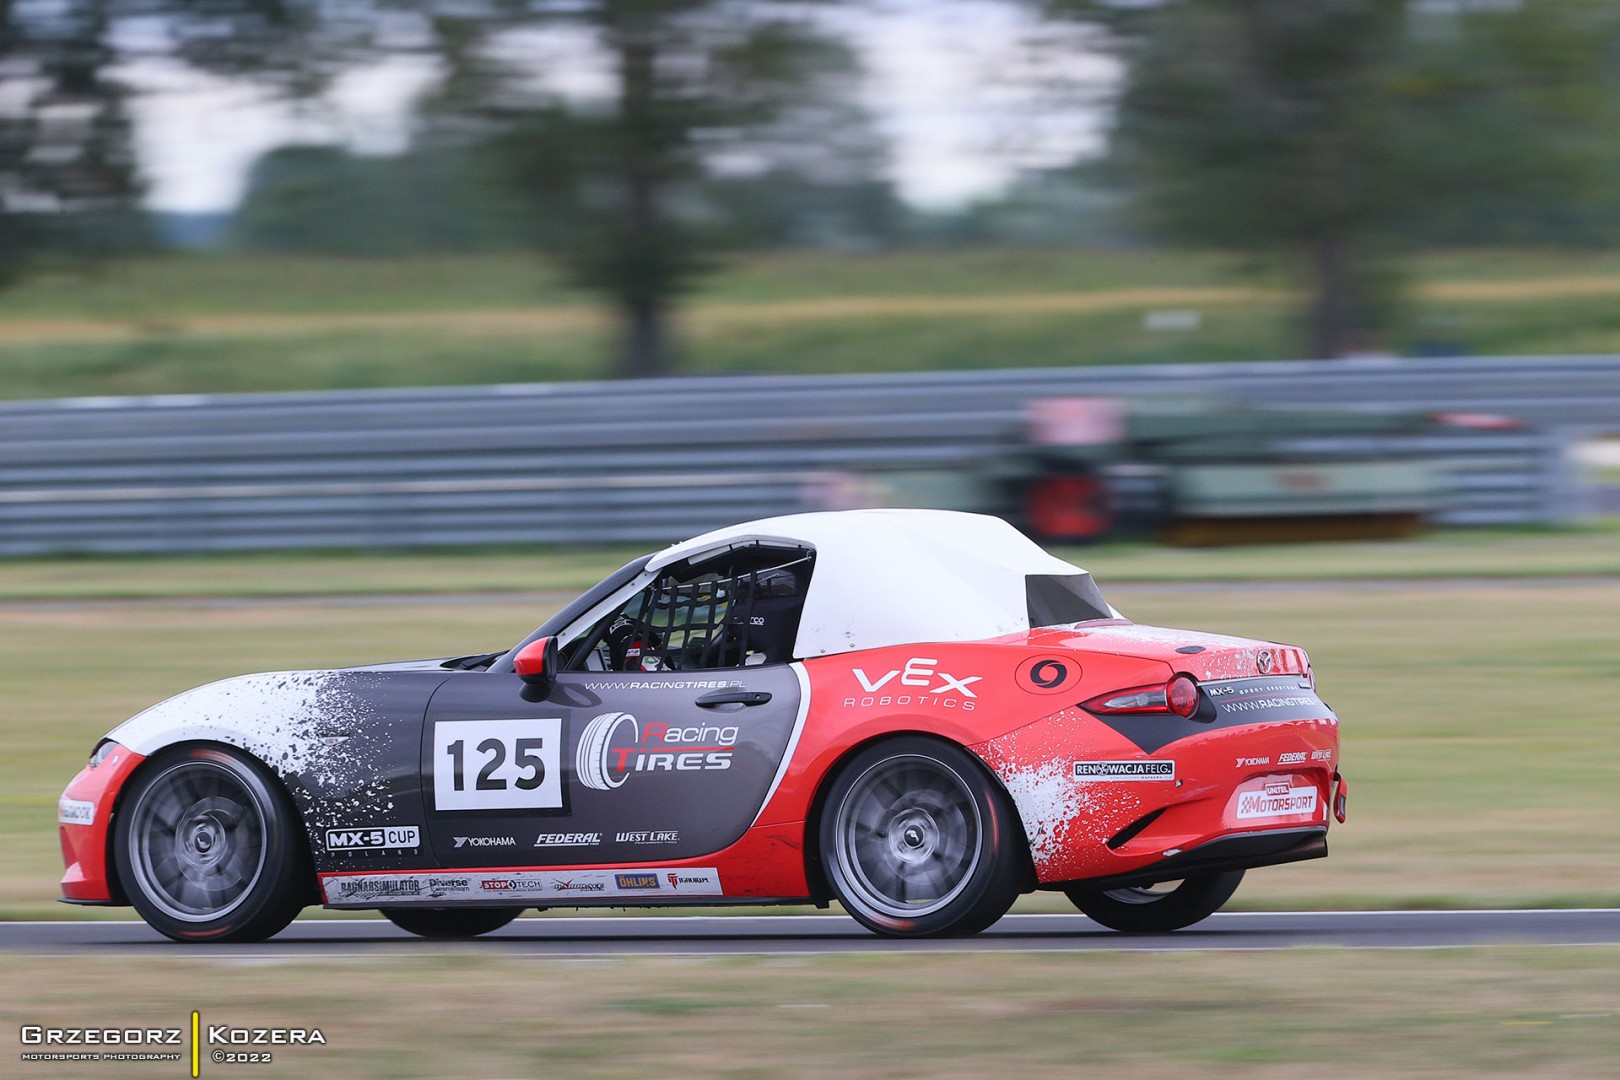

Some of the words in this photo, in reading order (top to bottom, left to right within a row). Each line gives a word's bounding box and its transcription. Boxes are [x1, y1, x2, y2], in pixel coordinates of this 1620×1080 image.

[851, 657, 984, 699] VEX
[585, 680, 747, 690] WWW.RACINGTIRES.PL
[1208, 686, 1235, 697] MX-5
[843, 695, 976, 711] ROBOTICS
[642, 722, 739, 747] Racing
[447, 737, 546, 792] 125
[329, 831, 384, 848] MX-5
[388, 830, 416, 844] CUP
[467, 836, 516, 847] YOKOHAMA
[535, 833, 601, 845] FEDERAL
[615, 832, 648, 843] WEST
[650, 831, 679, 842] LAKE
[331, 849, 418, 857] POLAND
[483, 881, 507, 889] STOP
[515, 880, 541, 888] TECH
[619, 875, 656, 888] ÖHLINS
